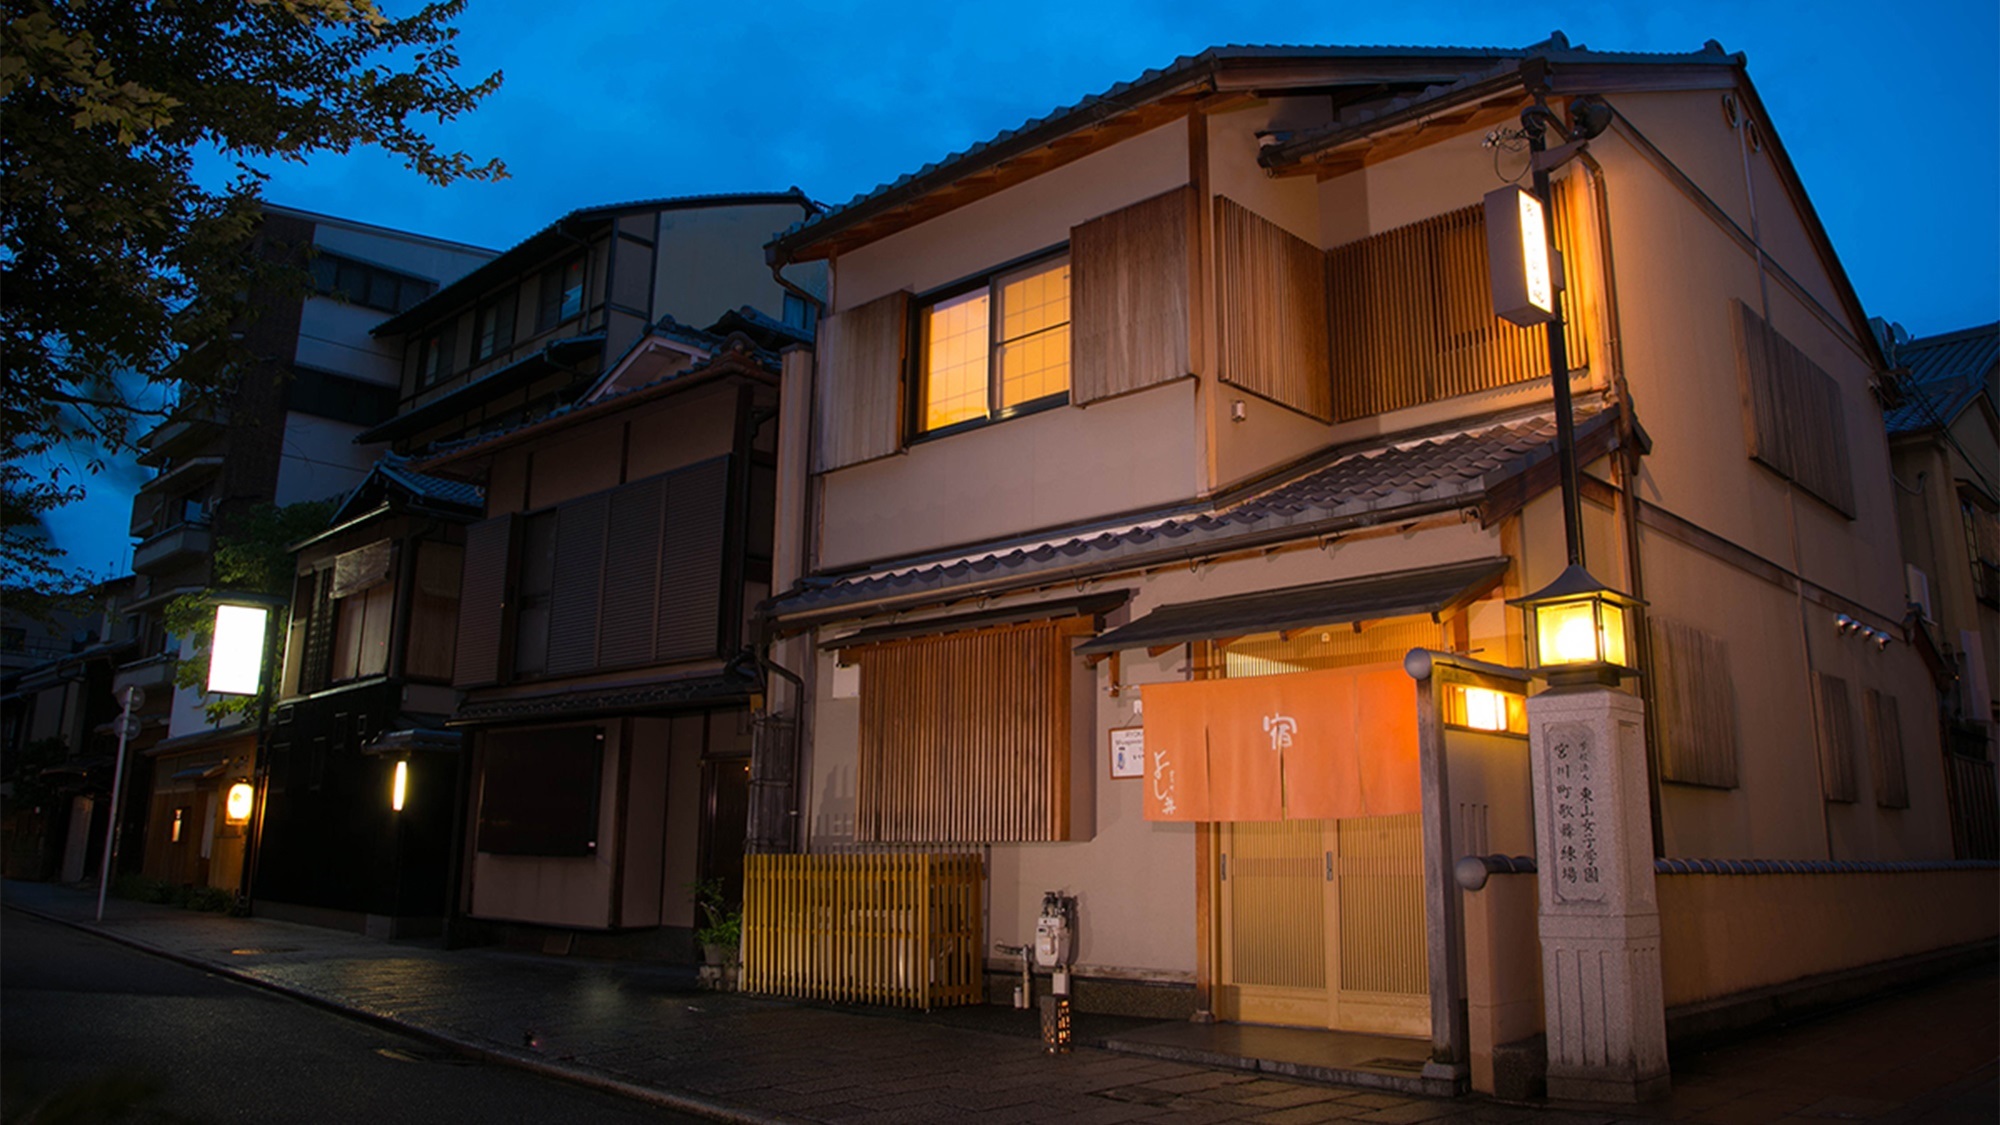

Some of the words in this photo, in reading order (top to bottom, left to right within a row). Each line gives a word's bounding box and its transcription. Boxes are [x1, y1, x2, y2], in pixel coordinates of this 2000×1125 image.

[1263, 713, 1298, 750] 宿
[1554, 742, 1578, 884] 宮川町歌舞練場
